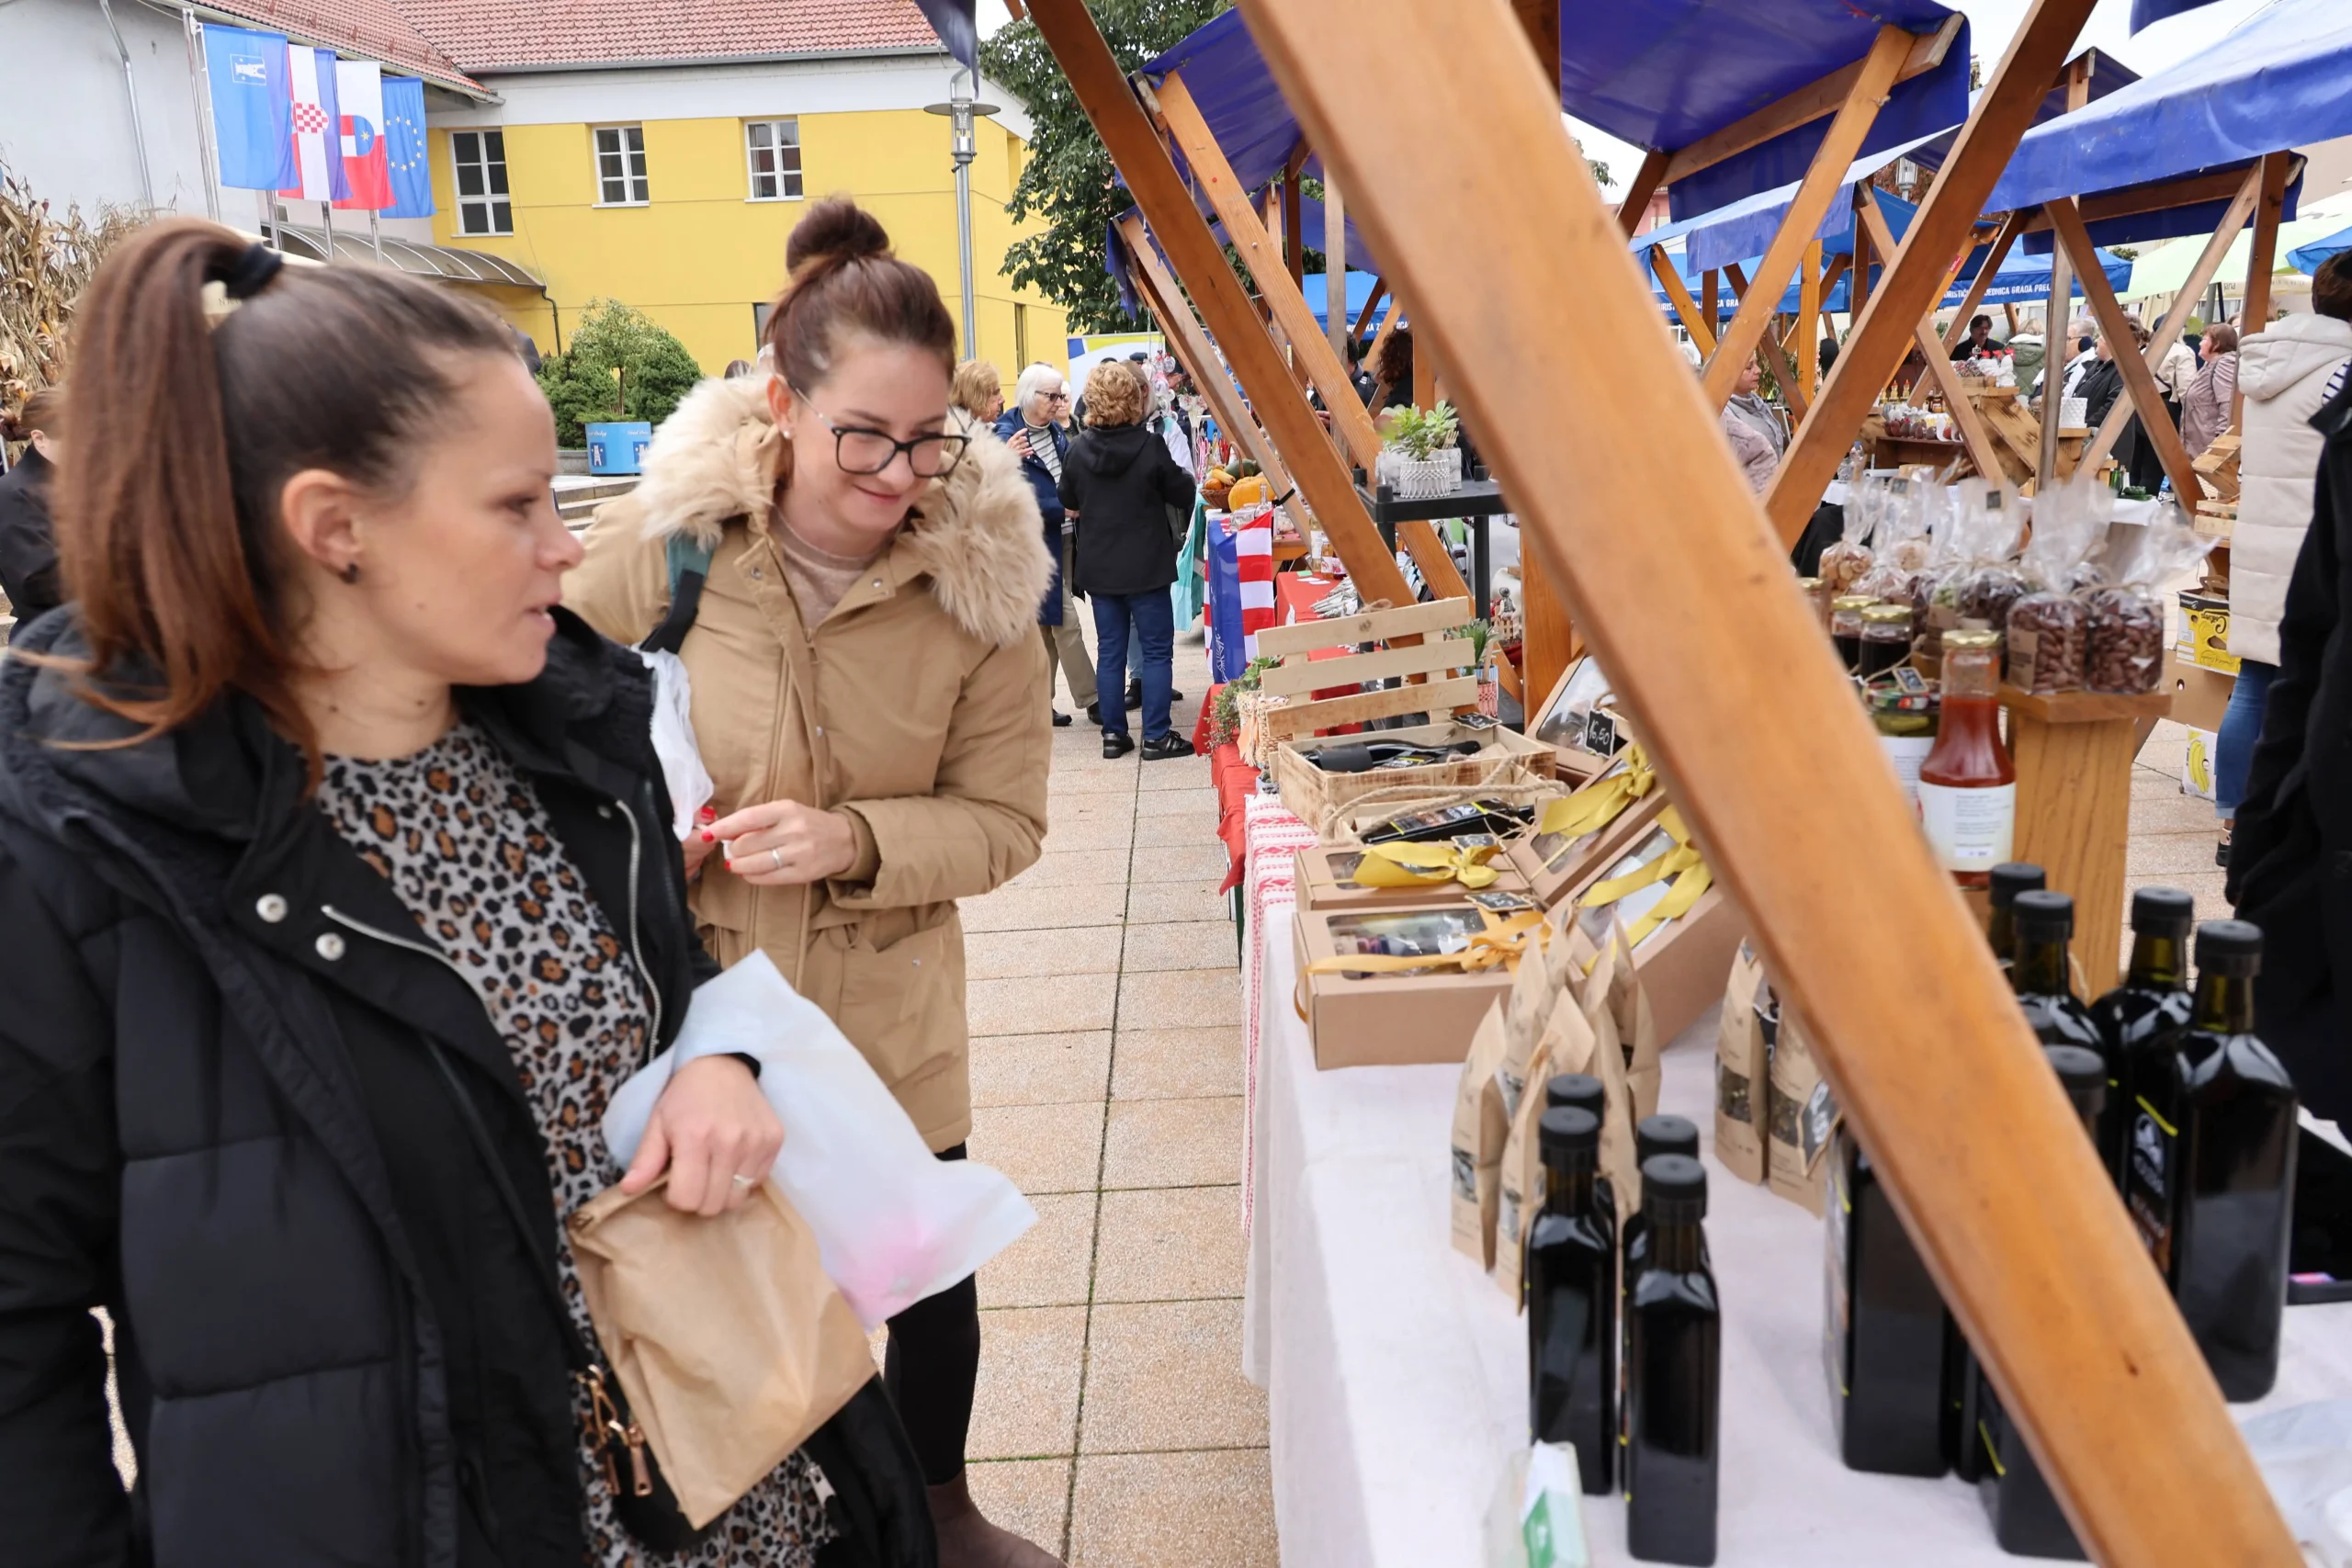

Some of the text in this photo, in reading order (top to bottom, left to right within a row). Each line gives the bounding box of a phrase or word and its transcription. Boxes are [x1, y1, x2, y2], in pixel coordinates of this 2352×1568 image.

[1984, 287, 2010, 297] JEDNICA
[2011, 285, 2033, 295] GRADA
[2034, 283, 2051, 293] PREL
[1725, 299, 1739, 308] GRA
